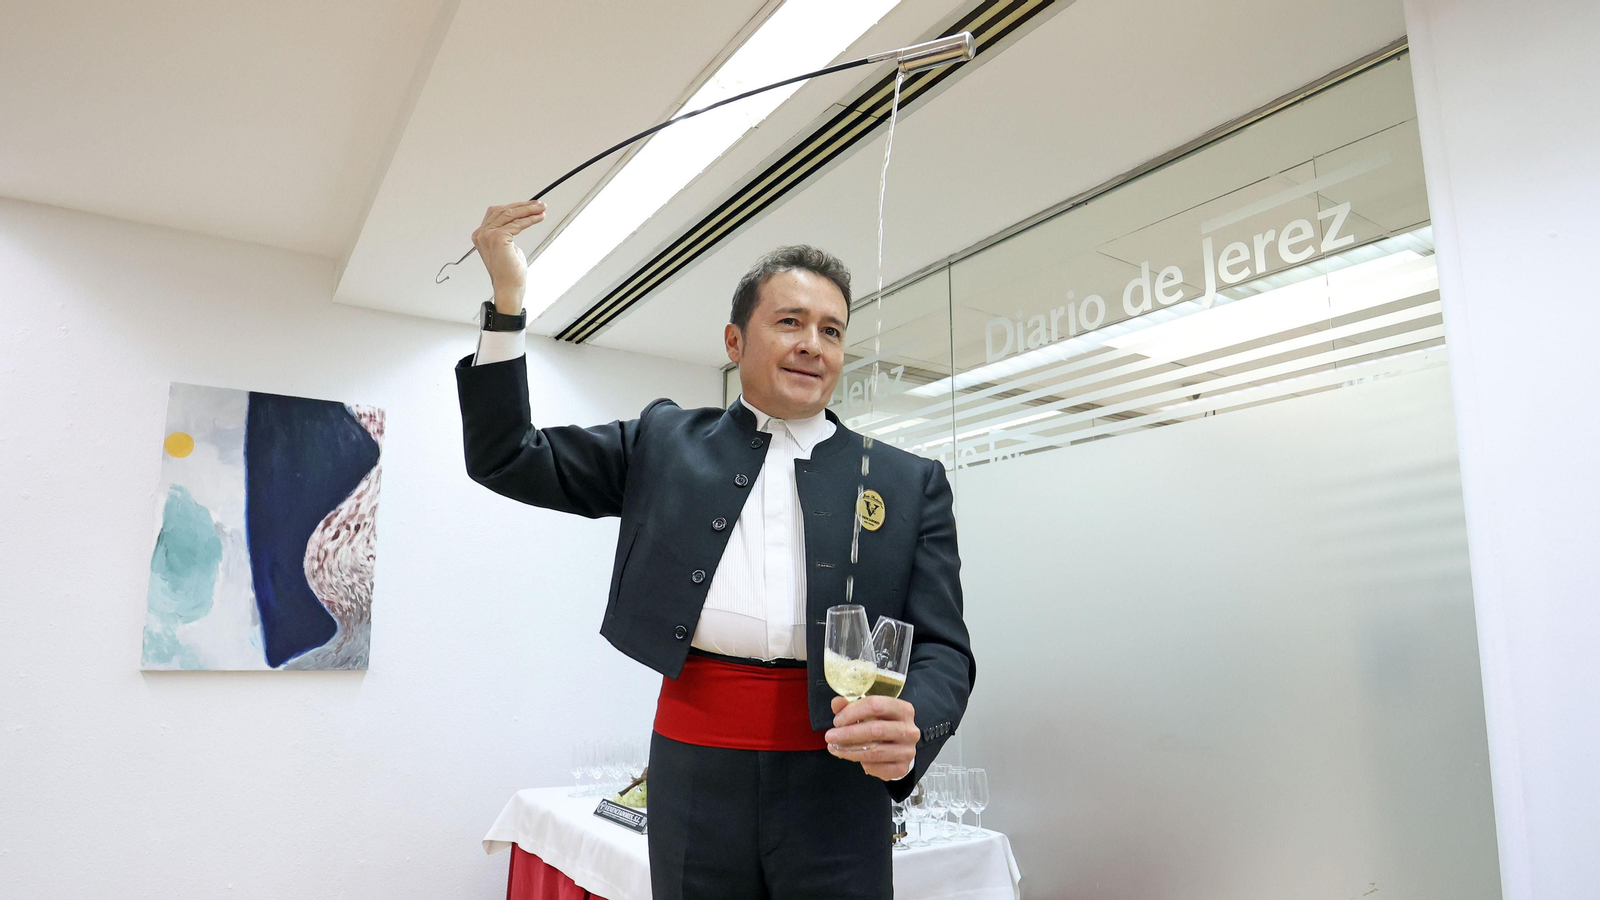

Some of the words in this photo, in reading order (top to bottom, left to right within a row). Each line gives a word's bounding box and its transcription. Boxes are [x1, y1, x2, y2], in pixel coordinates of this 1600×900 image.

[985, 289, 1106, 364] Diario
[1122, 261, 1184, 318] de
[1201, 201, 1356, 310] Jerez
